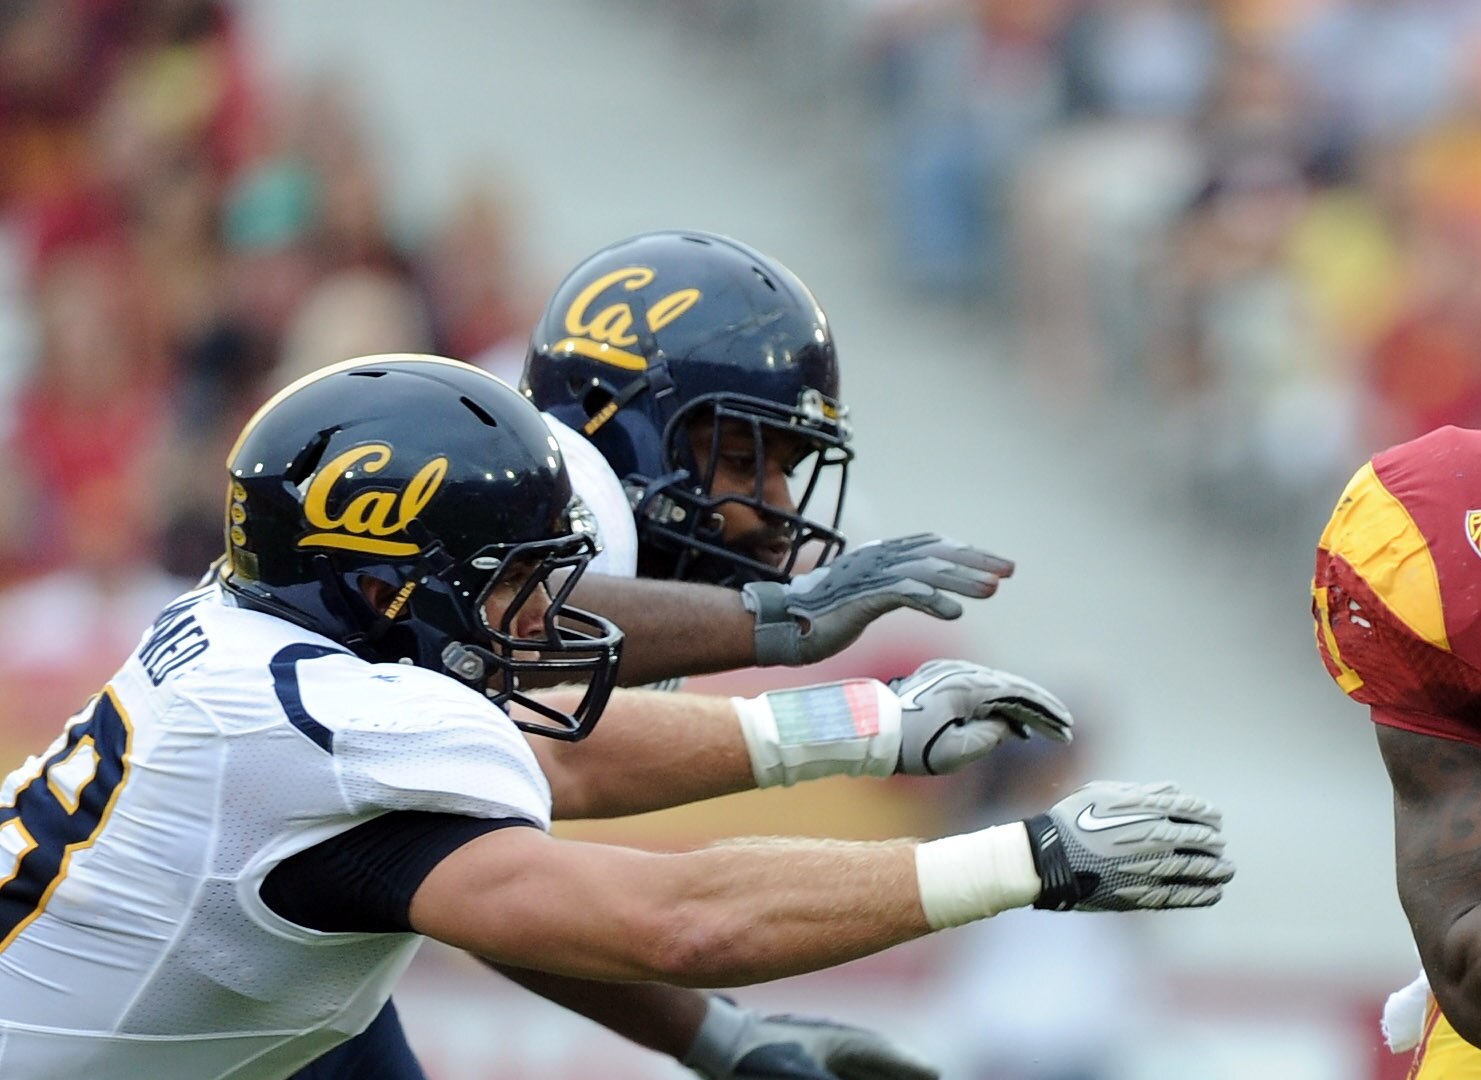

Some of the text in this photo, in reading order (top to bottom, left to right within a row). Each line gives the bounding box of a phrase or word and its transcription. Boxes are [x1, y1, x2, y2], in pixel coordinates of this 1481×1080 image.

[565, 266, 701, 348] Cal
[304, 444, 449, 536] Cal
[383, 580, 417, 620] BEARS
